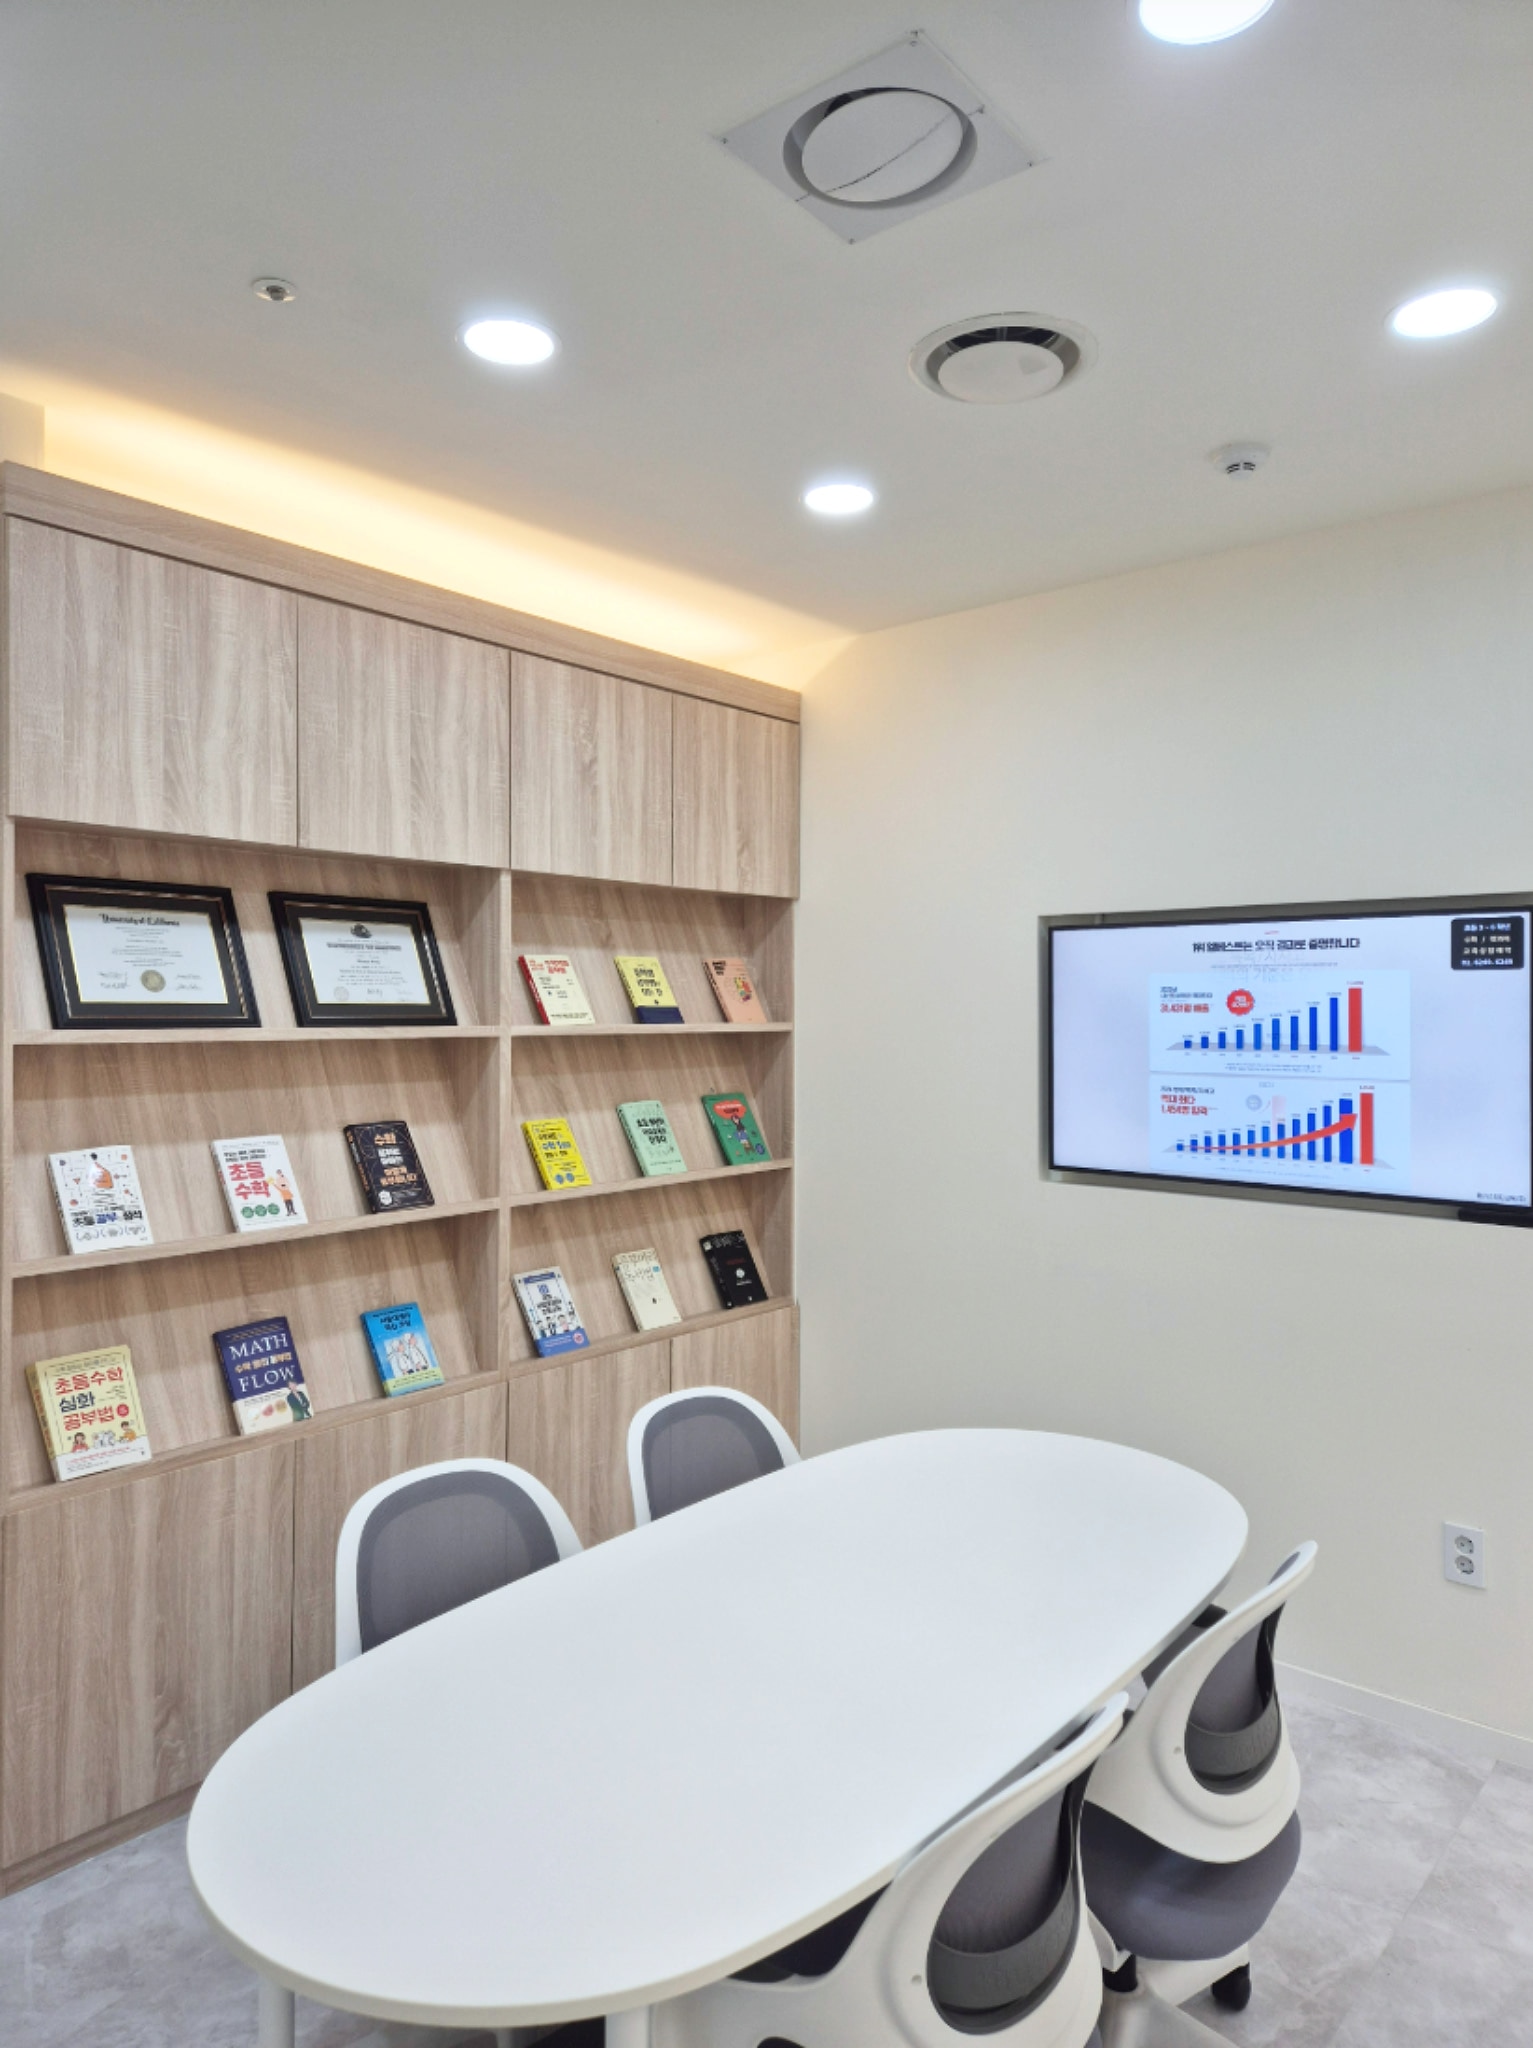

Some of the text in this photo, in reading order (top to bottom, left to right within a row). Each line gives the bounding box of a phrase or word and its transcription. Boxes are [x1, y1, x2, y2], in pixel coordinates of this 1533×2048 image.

[235, 1180, 271, 1200] 수학
[229, 1333, 289, 1360] MATH
[54, 1366, 124, 1396] 초등수학
[238, 1365, 296, 1393] FLOW
[59, 1391, 95, 1413] 심화
[63, 1405, 115, 1431] 공부법
